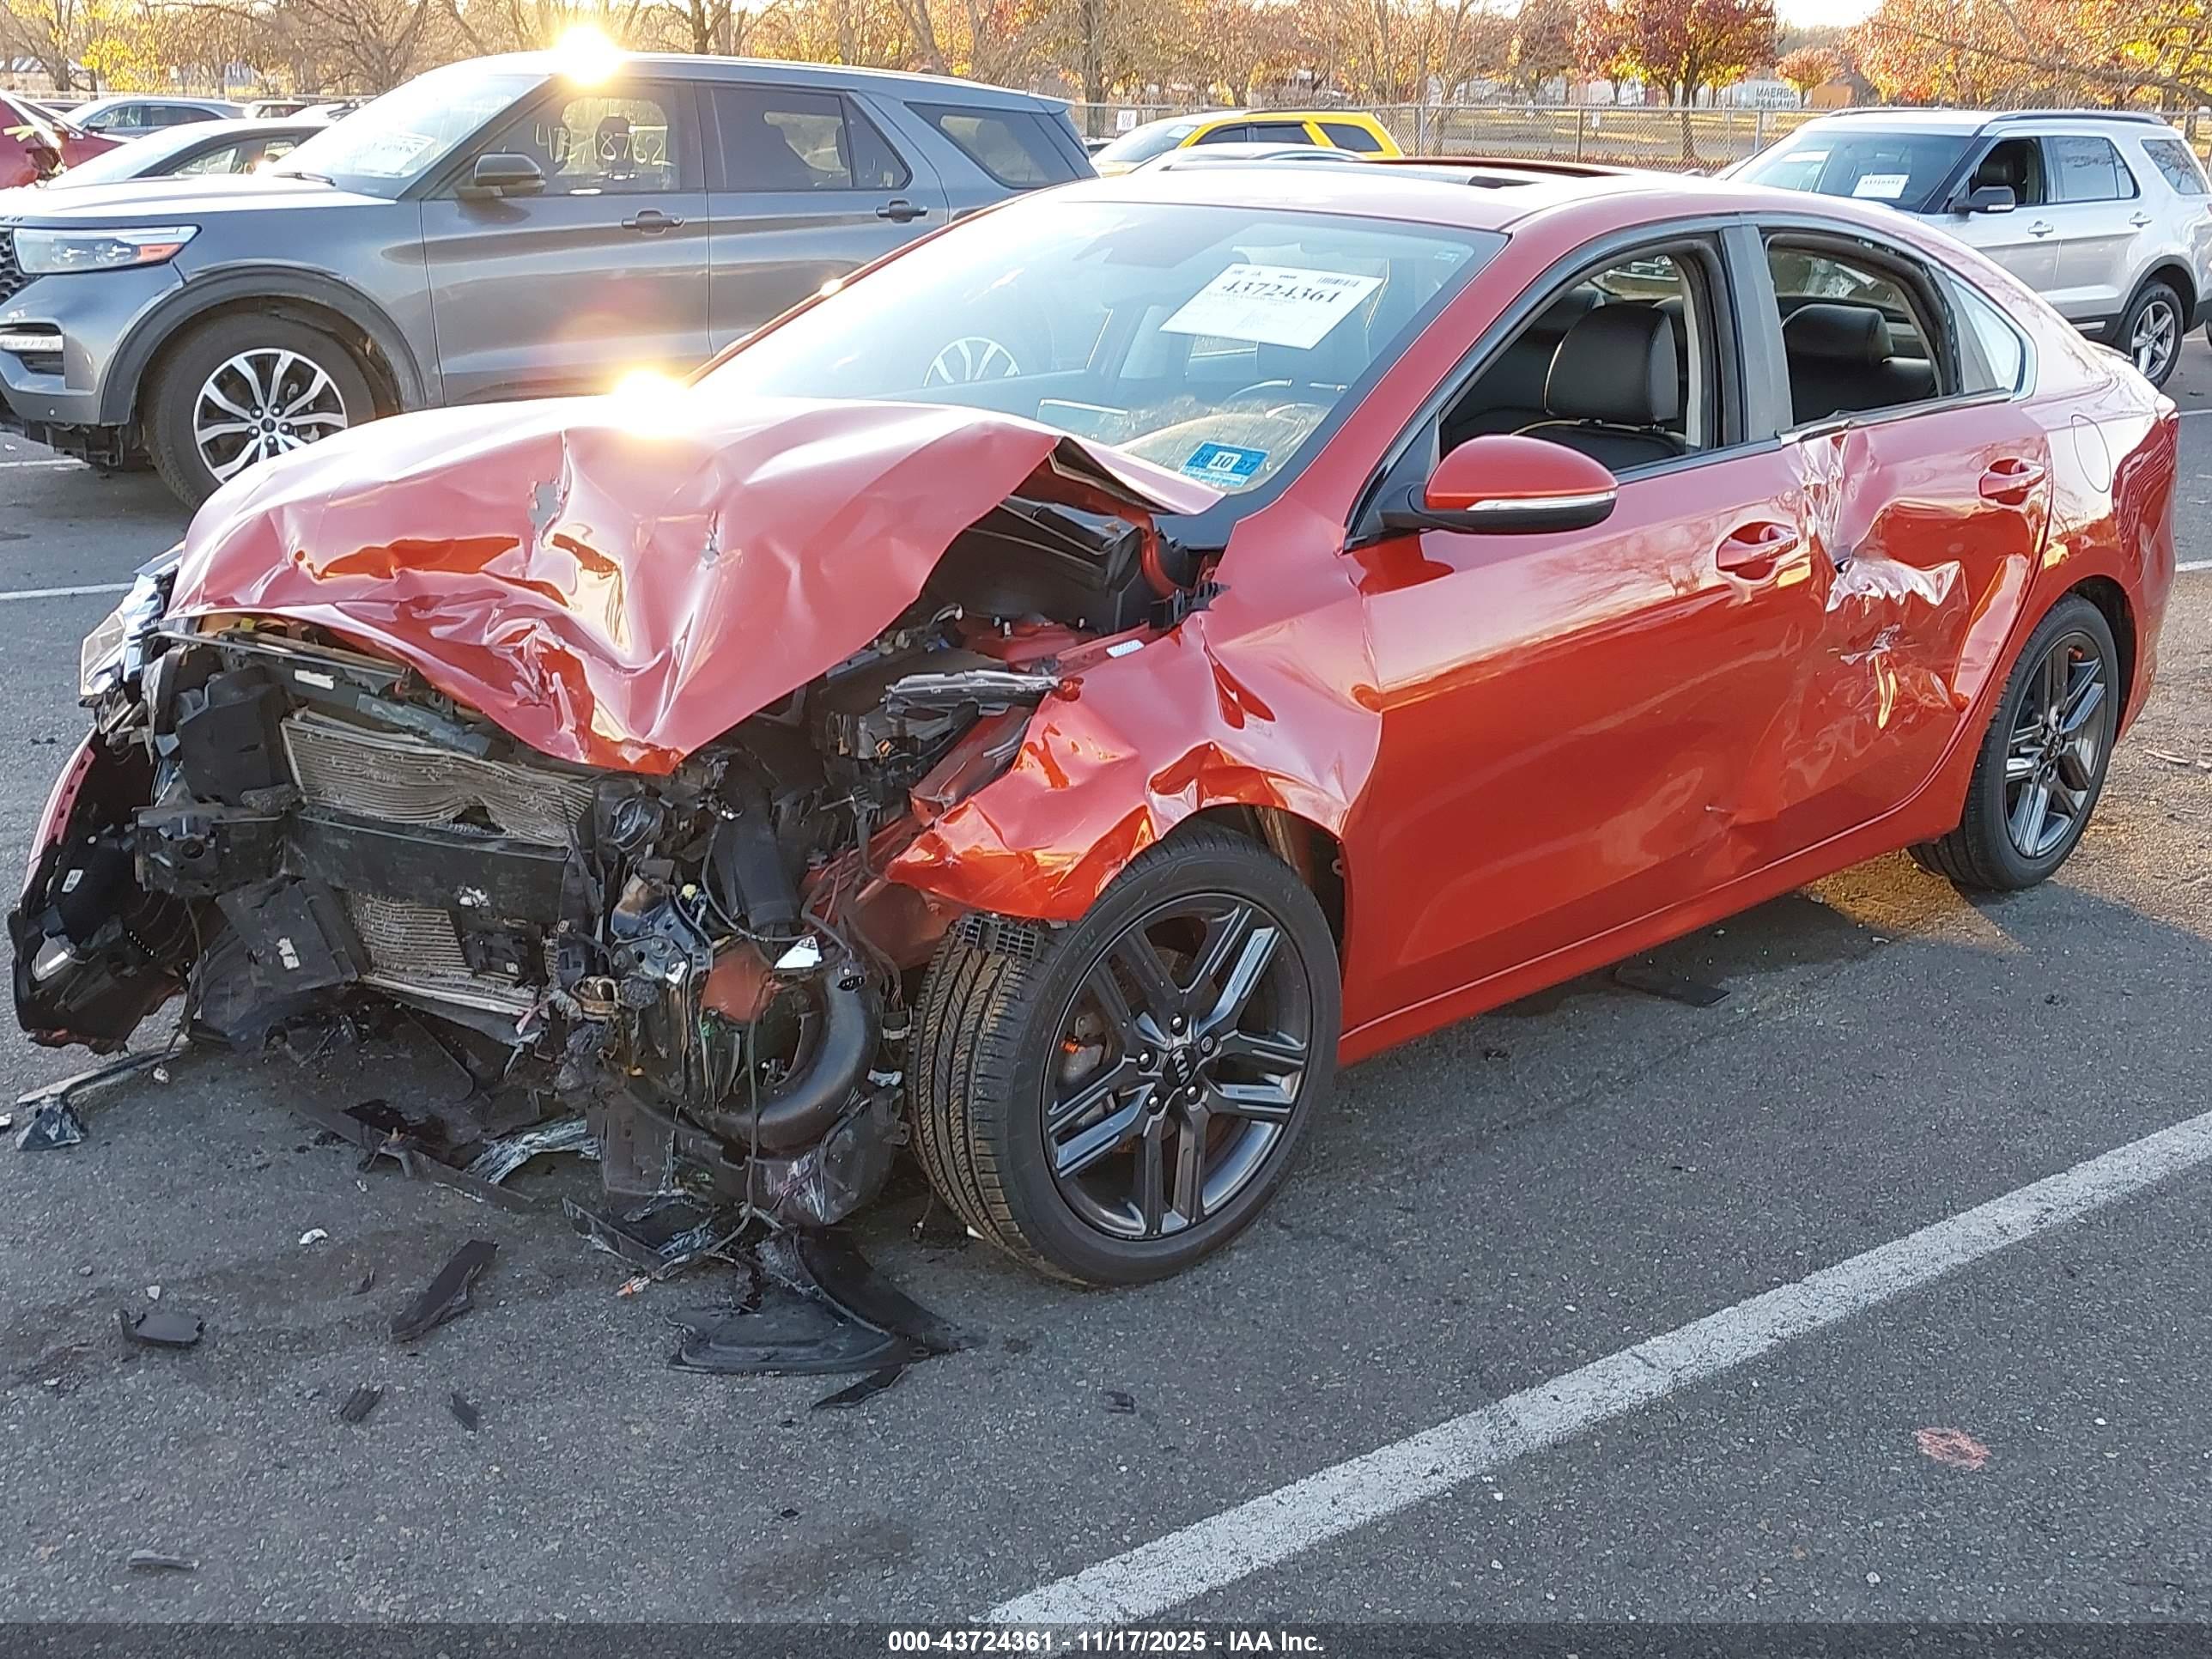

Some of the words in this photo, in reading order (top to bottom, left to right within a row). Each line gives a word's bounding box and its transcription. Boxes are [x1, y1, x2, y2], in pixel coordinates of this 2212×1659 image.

[1221, 279, 1341, 302] 43724361
[1211, 454, 1235, 468] 10
[1172, 1048, 1190, 1085] KIA
